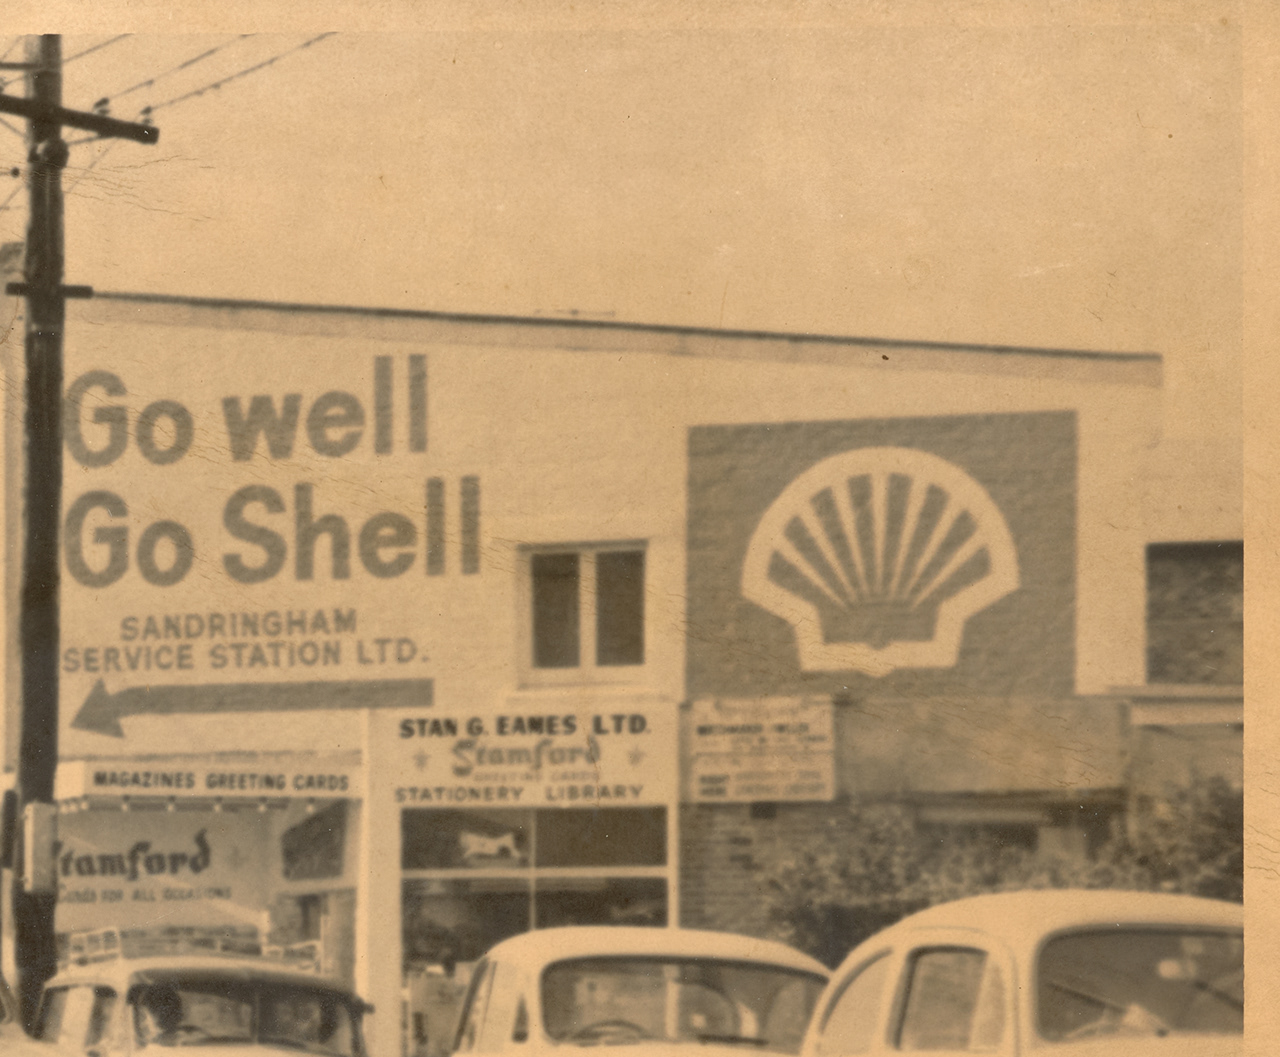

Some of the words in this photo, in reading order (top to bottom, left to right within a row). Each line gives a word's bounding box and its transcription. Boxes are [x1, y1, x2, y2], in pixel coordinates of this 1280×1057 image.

[65, 369, 195, 468] Go
[221, 354, 428, 462] well
[64, 489, 195, 588] Go
[222, 475, 481, 585] Shell
[120, 608, 358, 642] SANDRINGHAM
[62, 643, 194, 673] SERVICE
[209, 639, 339, 669] STATION
[356, 637, 430, 665] LTD.
[399, 717, 458, 739] STAN
[496, 714, 577, 736] EAMES
[451, 735, 601, 777] Stamford
[93, 770, 195, 789] MAGAZINES
[205, 772, 286, 791] GREETING
[292, 773, 349, 791] CARDS
[395, 785, 524, 803] STATIONERY
[544, 784, 644, 801] LIBRARY
[52, 828, 211, 882] tamford
